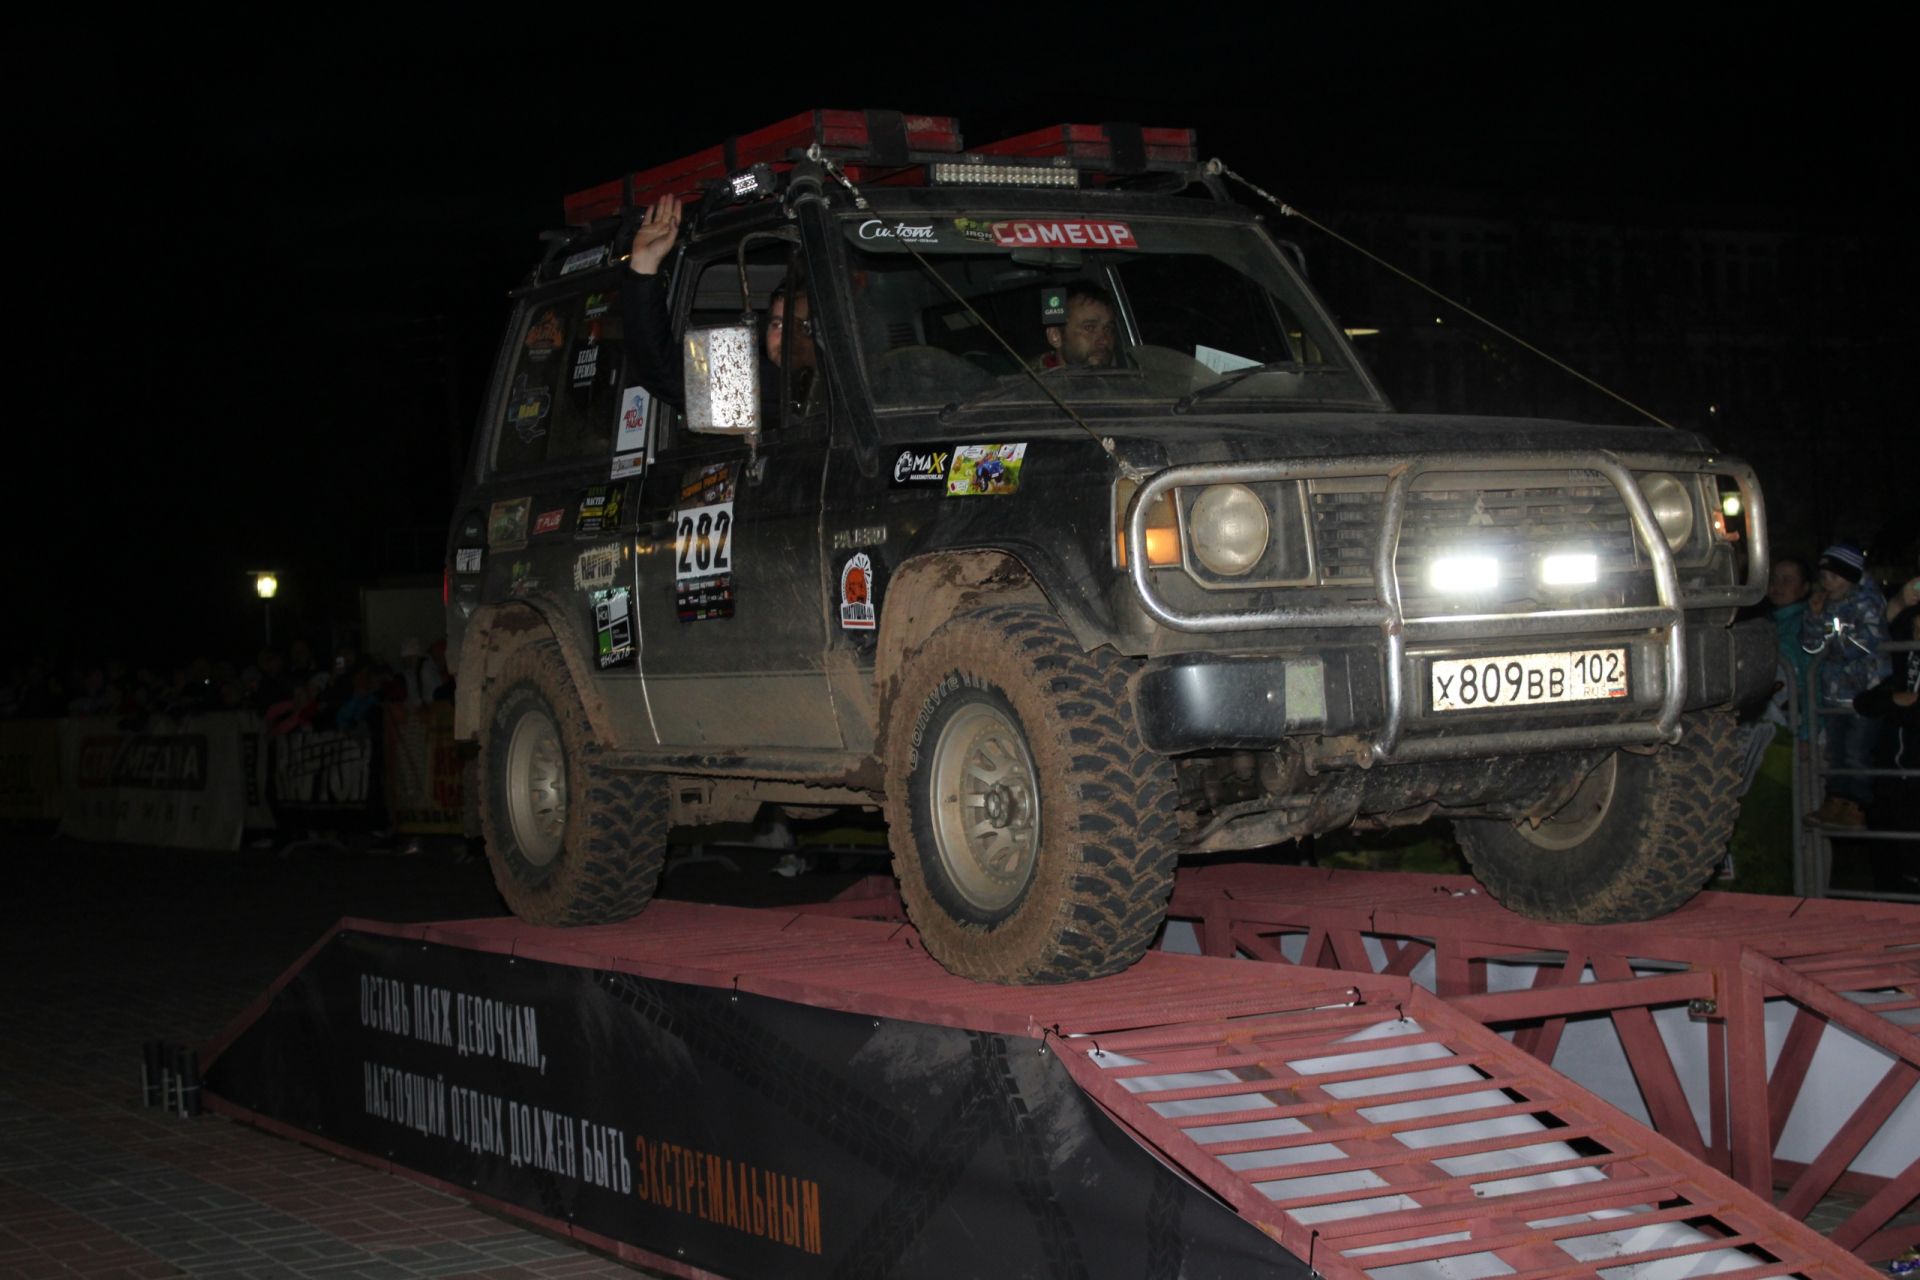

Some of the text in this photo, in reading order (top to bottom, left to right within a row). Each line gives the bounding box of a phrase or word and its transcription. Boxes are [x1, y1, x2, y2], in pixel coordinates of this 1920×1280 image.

[993, 222, 1131, 245] COMEUP
[678, 511, 730, 573] 282
[1574, 653, 1620, 684] 102
[1583, 686, 1608, 697] RUS
[360, 973, 548, 1075] ОСТАВЬ ПЛЯЖ ДЕВОЧКАМ,
[363, 1060, 823, 1255] НАСТОЯЩИЙ ОТДЫХ ДОЛЖЕН БЫТЬ ЭКСТРЕМАЛЬНЫМ
